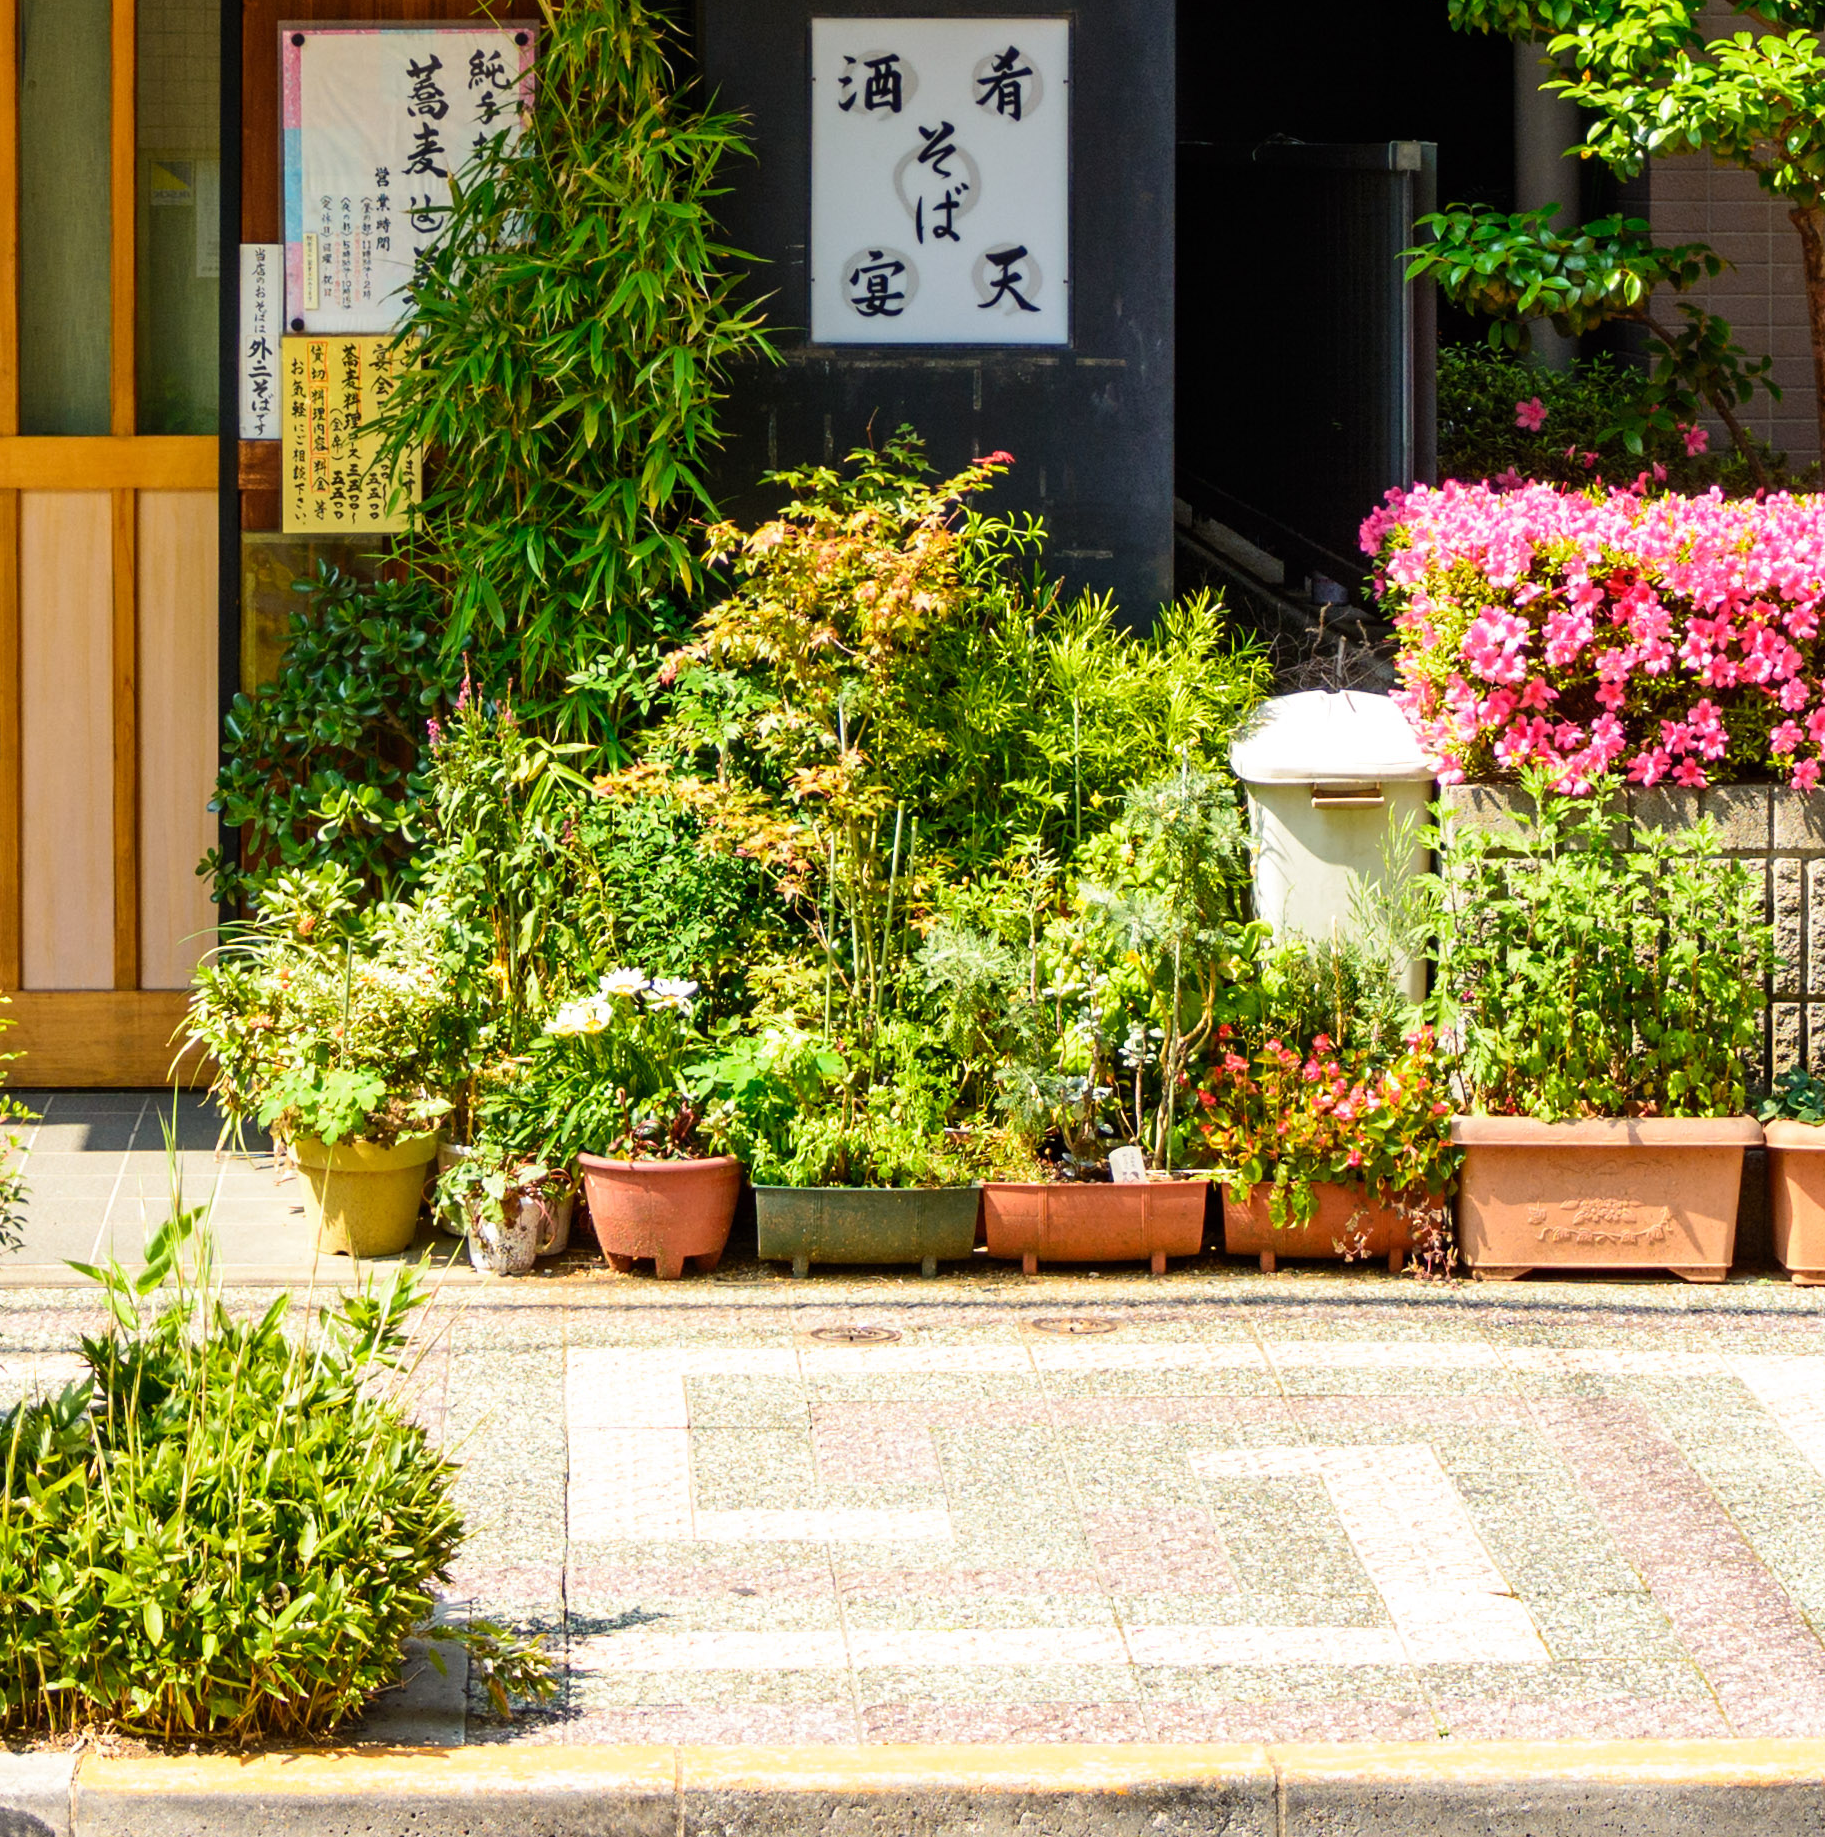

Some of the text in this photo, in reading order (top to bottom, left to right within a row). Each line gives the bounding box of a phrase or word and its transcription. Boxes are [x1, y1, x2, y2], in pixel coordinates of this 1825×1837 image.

[838, 53, 903, 114] 酒
[975, 45, 1033, 122] 肴
[374, 167, 392, 253] 営業時間
[914, 121, 970, 244] そば
[849, 250, 906, 317] 宴
[978, 245, 1041, 312] 天
[310, 344, 329, 521] 貸切 料理内容 料金 等
